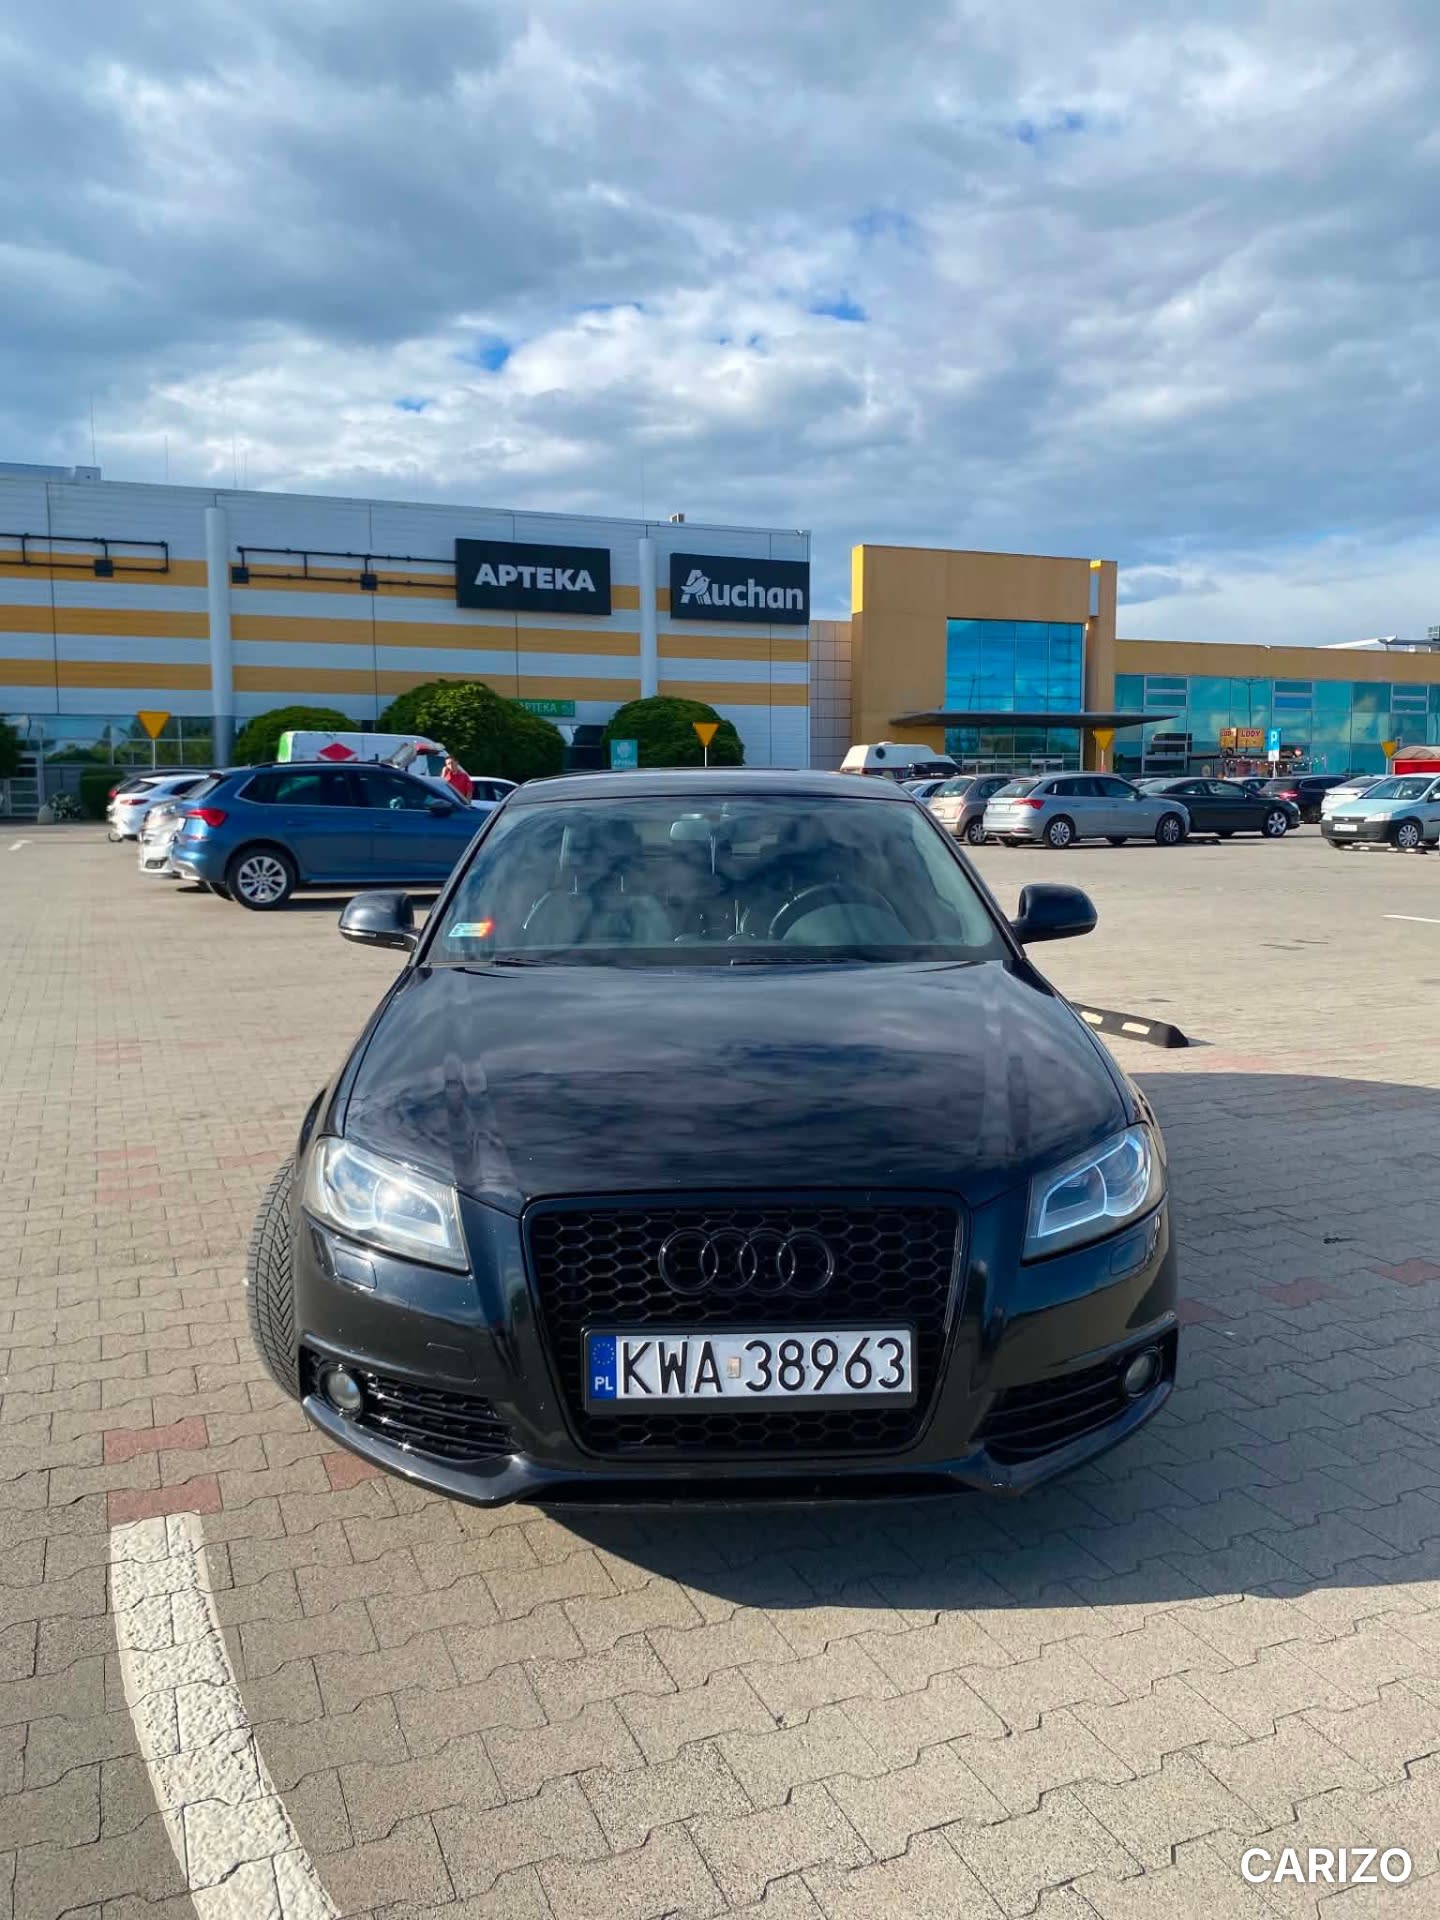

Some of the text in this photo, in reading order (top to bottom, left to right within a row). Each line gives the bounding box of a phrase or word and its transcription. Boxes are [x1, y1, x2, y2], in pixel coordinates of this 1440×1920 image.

[474, 563, 596, 593] APTEKA
[680, 569, 804, 610] Auchan
[1241, 729, 1261, 738] LODY
[621, 1337, 905, 1394] KWA 38963
[595, 1376, 614, 1391] PL
